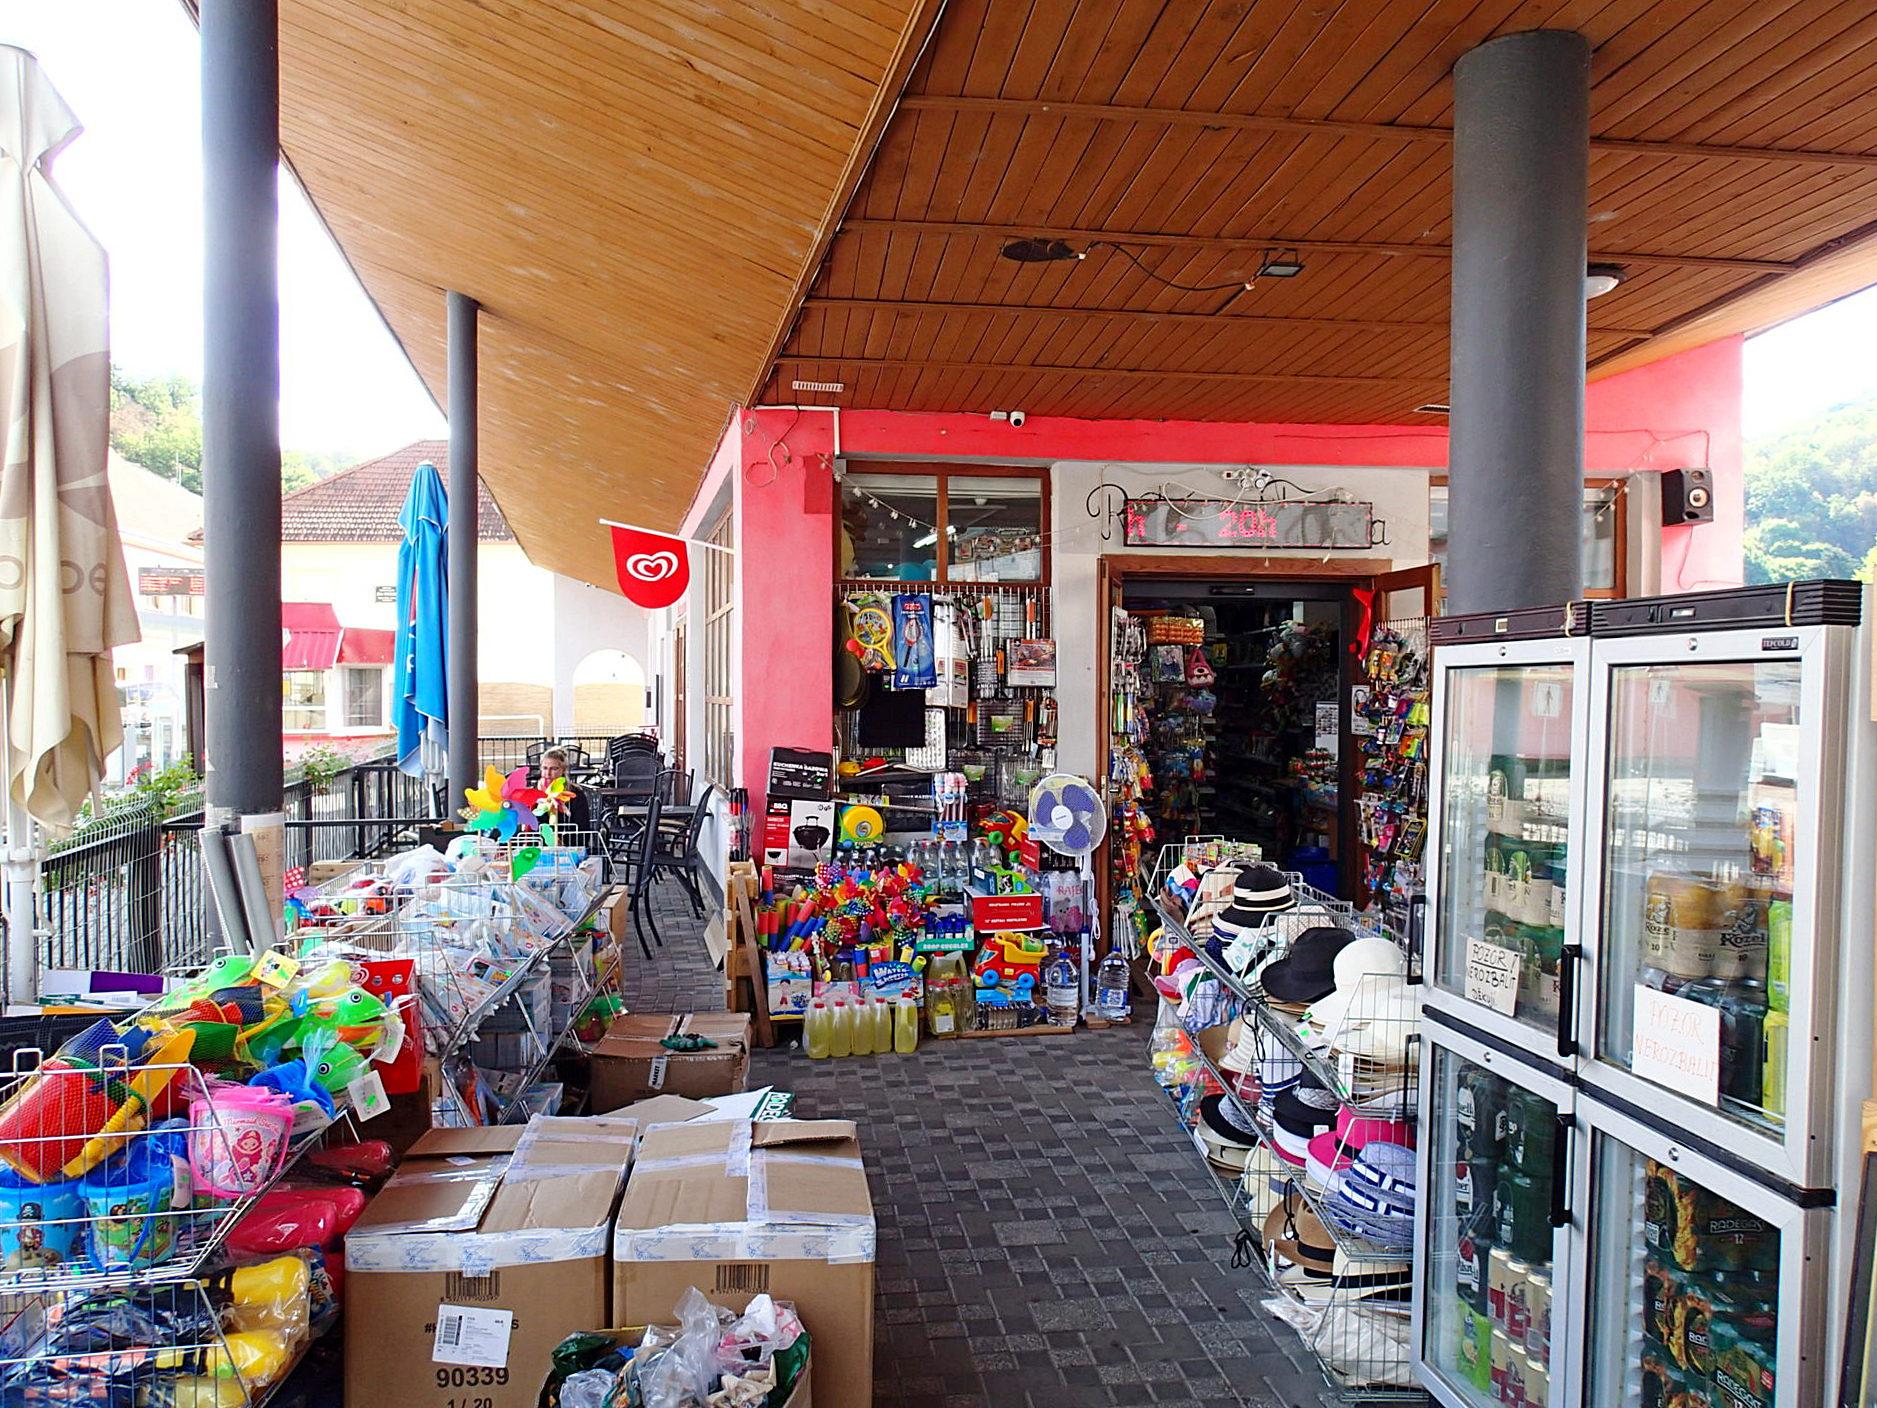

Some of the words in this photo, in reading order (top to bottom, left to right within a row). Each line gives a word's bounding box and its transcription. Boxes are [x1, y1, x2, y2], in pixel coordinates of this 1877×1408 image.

[1218, 509, 1277, 538] 20h
[1720, 932, 1766, 948] Kozel
[1649, 1000, 1704, 1046] POZOR
[436, 1366, 510, 1388] 90339
